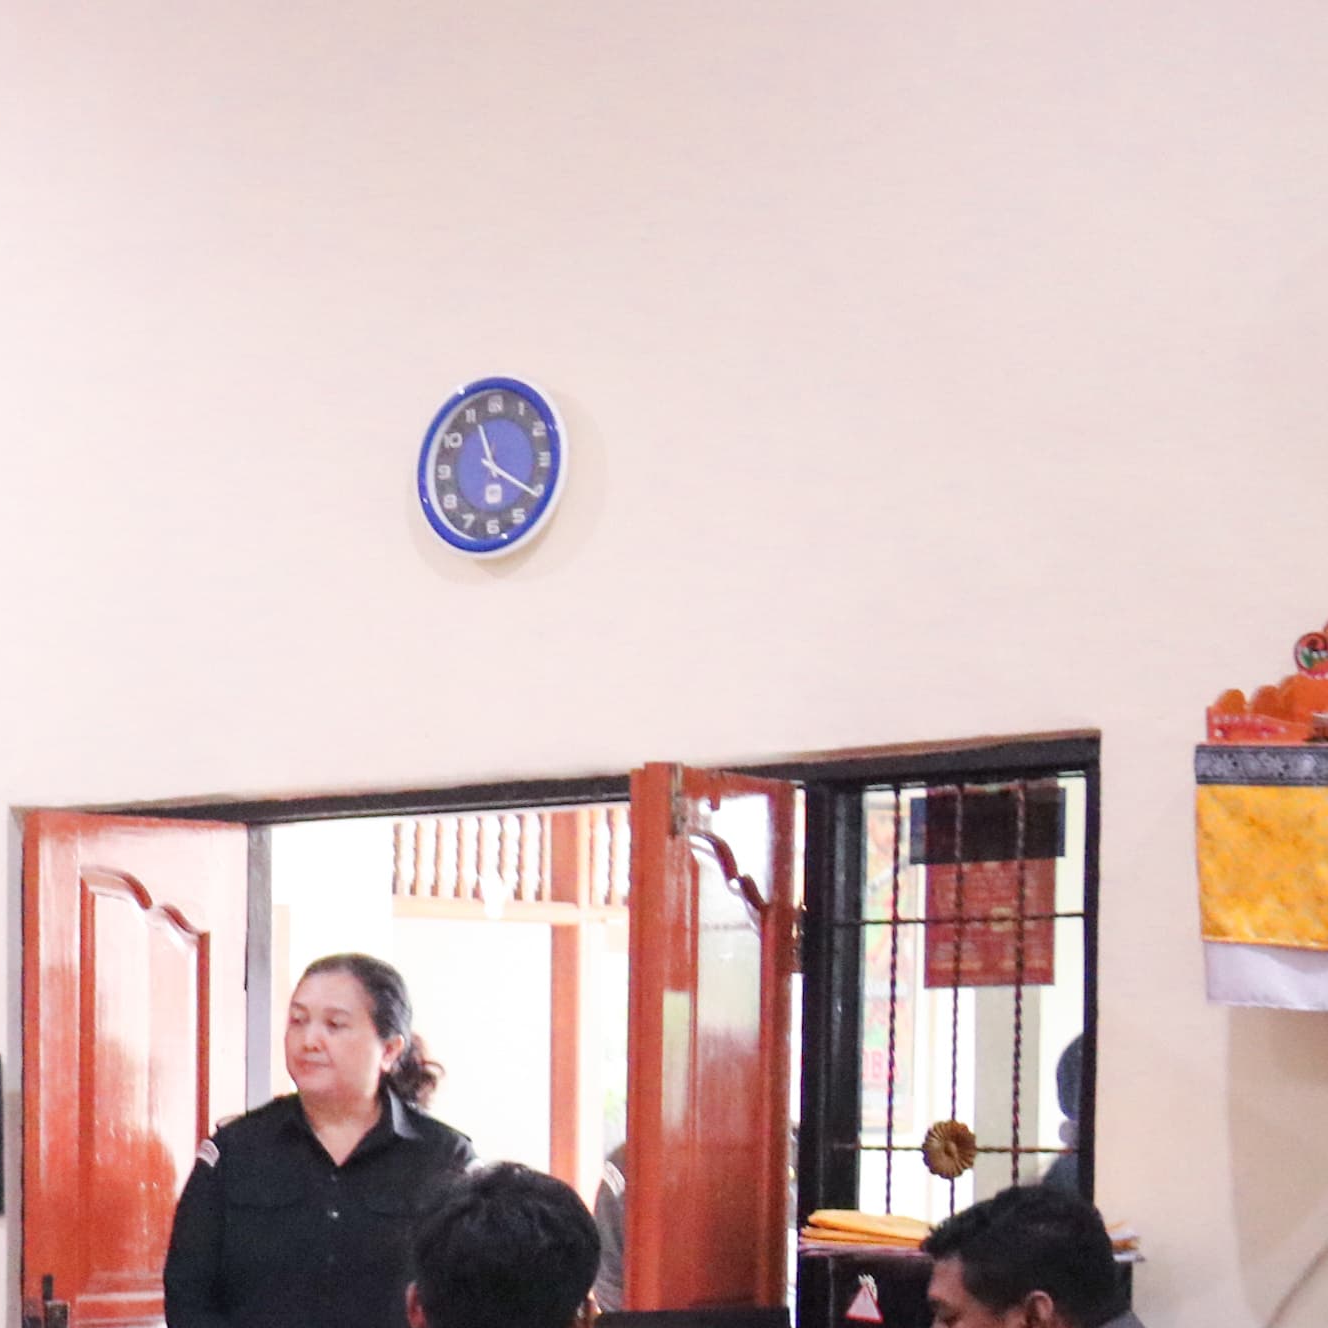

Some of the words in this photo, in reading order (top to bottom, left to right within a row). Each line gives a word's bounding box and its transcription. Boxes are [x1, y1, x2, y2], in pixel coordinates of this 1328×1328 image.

[438, 464, 452, 481] 9
[444, 494, 458, 509] 8
[462, 513, 475, 529] 7
[512, 508, 526, 524] 5
[486, 519, 500, 535] 6
